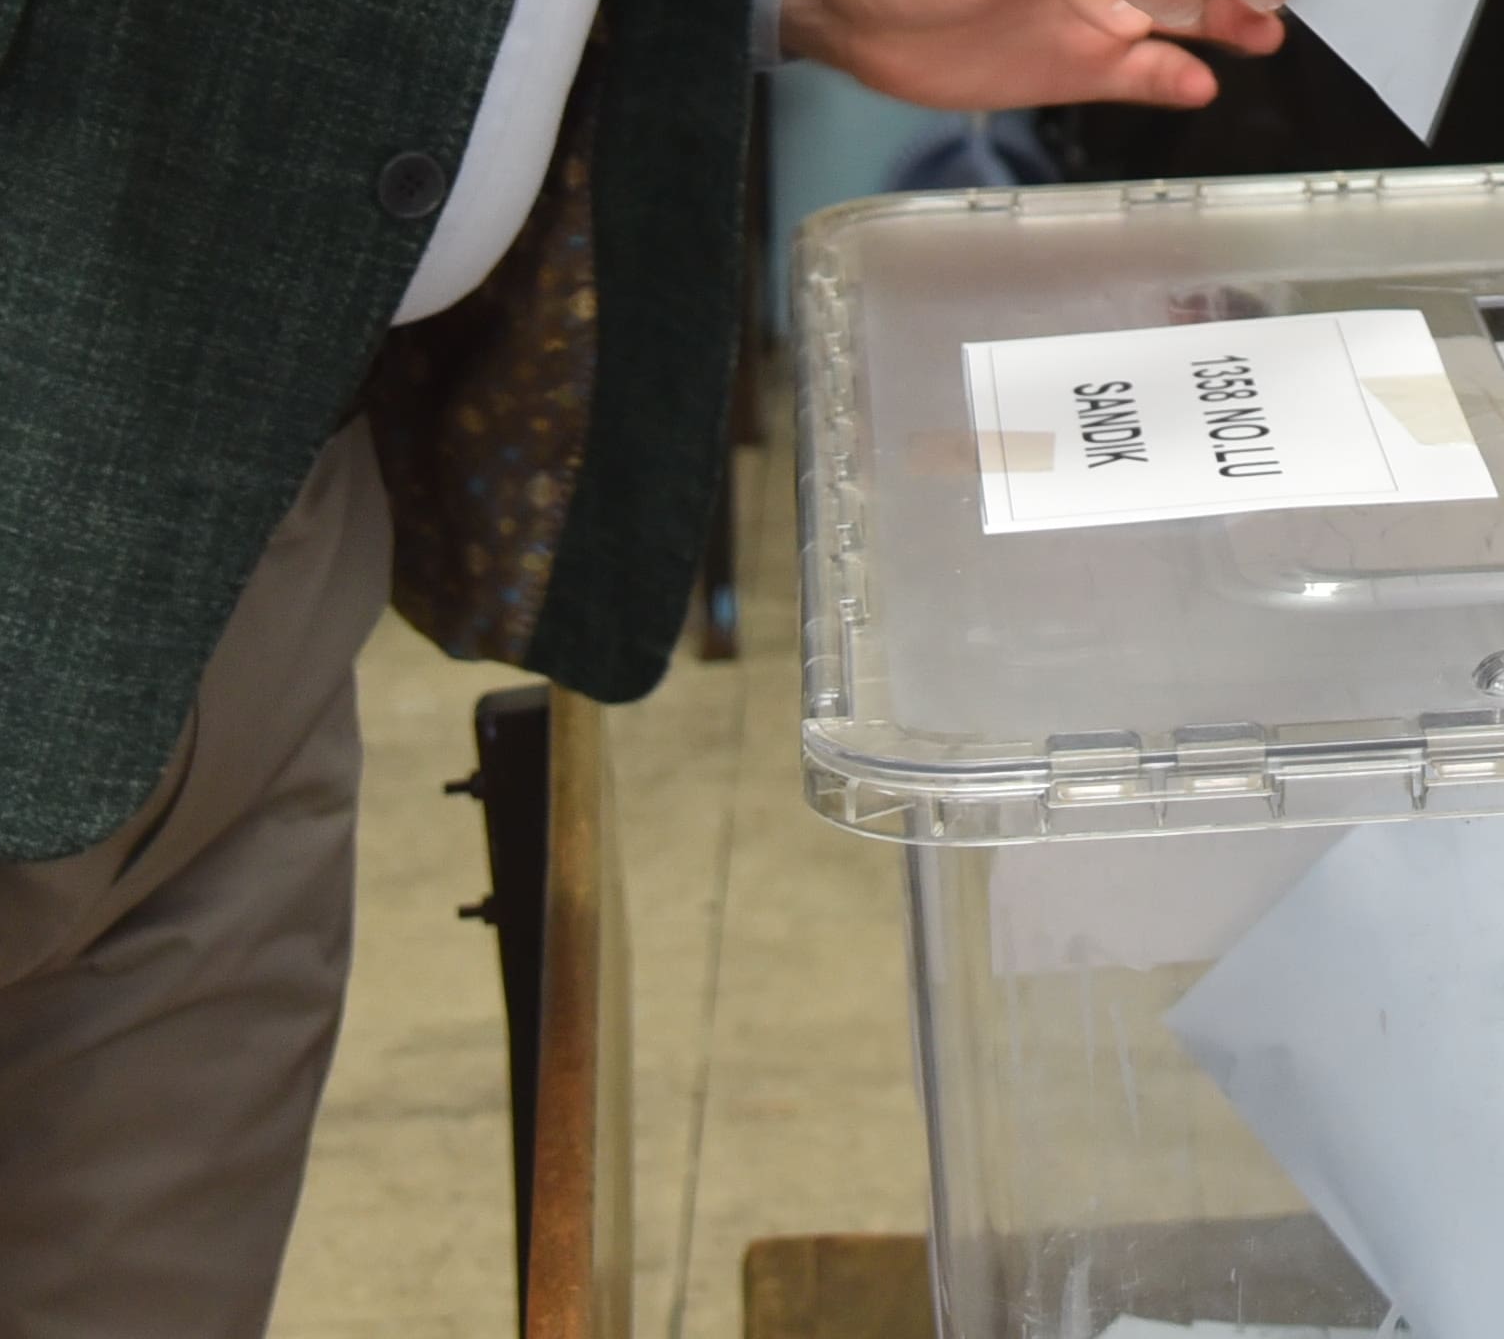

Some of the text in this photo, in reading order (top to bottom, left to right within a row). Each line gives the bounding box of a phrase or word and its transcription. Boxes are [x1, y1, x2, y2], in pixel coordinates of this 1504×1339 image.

[1073, 380, 1149, 469] SANDIK
[1191, 355, 1283, 478] 1358 NO.LU
